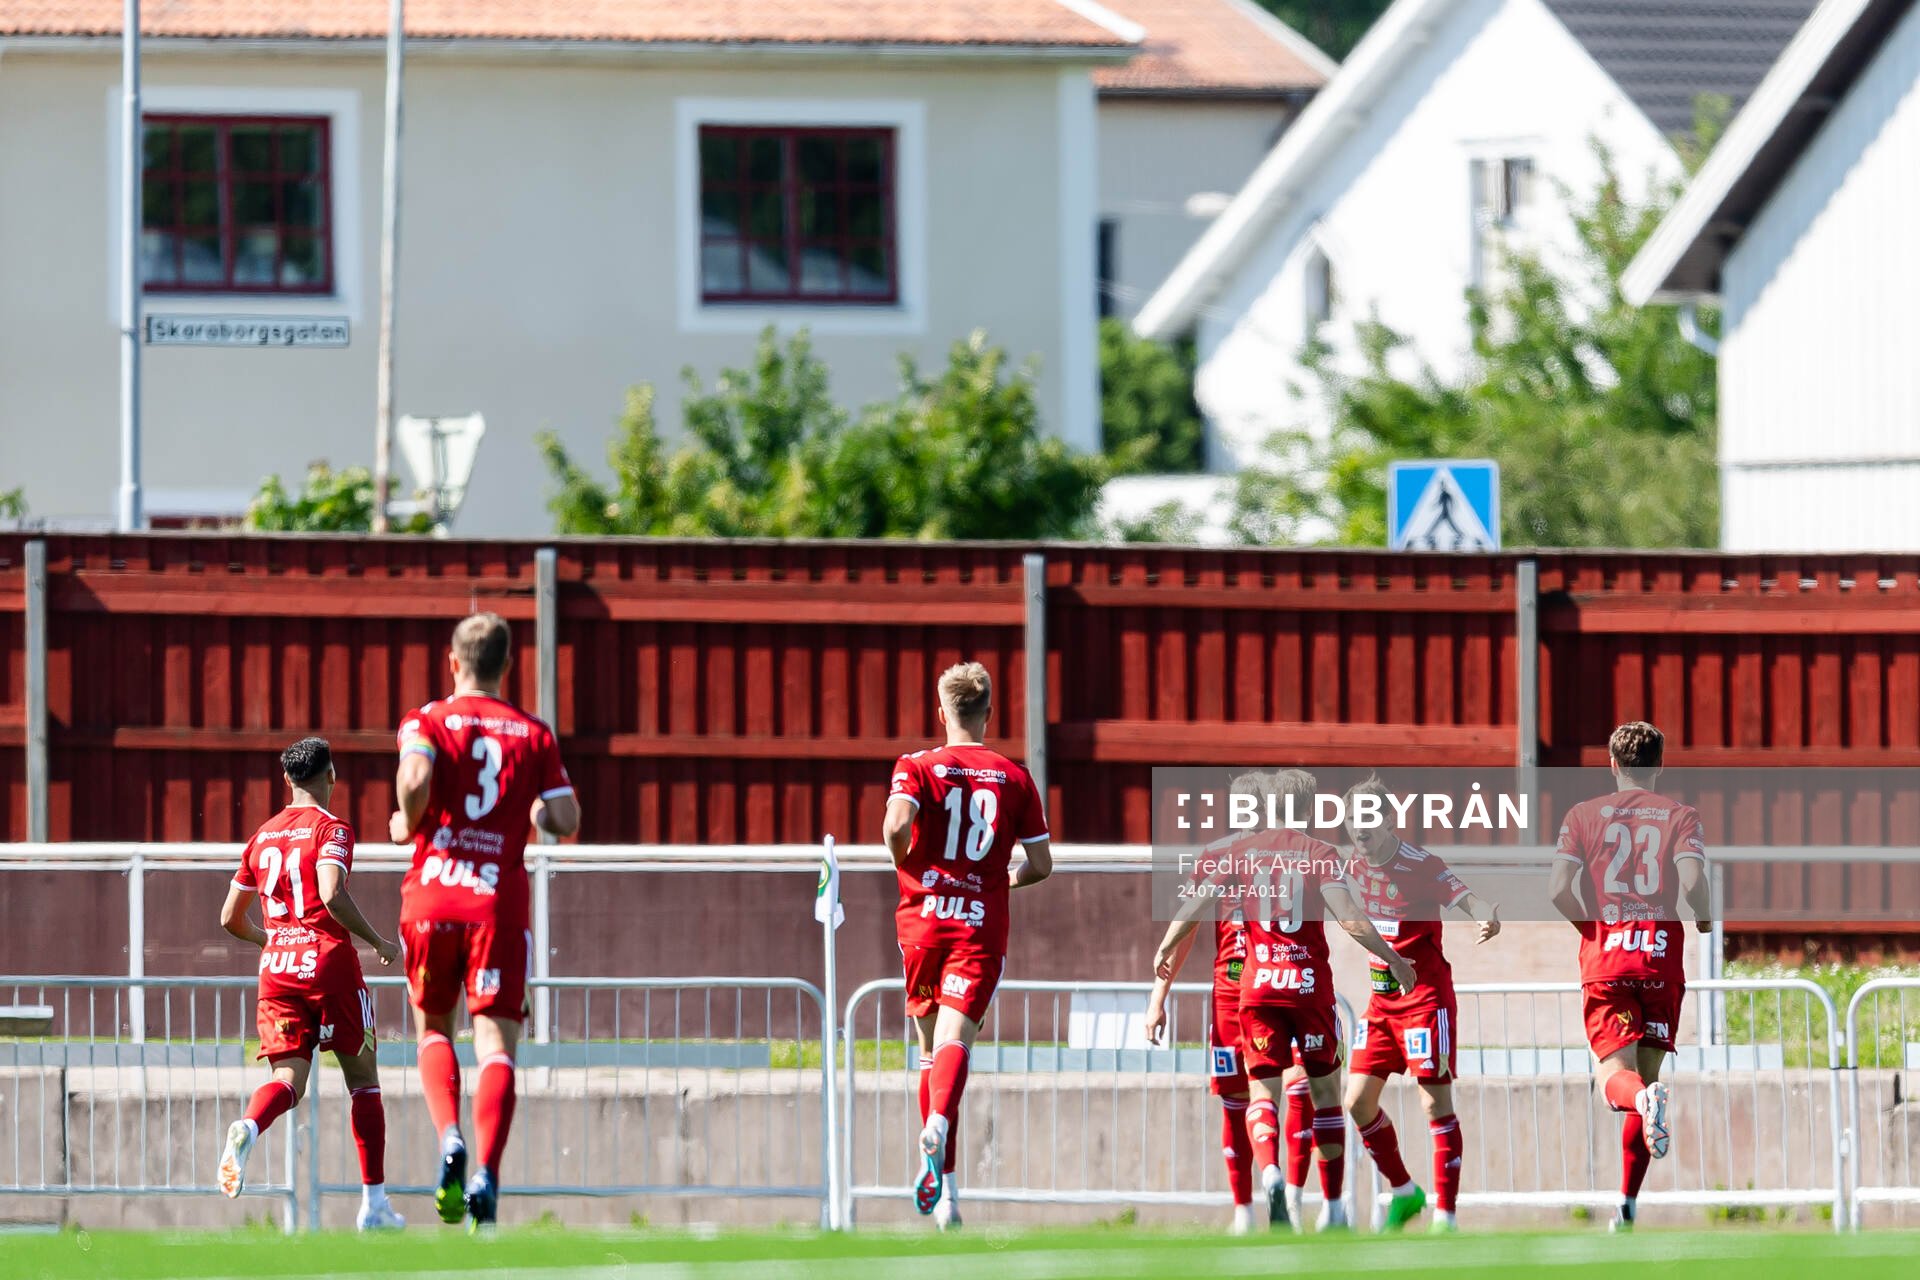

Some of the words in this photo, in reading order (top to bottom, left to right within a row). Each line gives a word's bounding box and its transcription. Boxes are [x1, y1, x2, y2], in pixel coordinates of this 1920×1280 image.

[155, 320, 346, 346] Skaraborgsgatan
[465, 736, 502, 821] 3
[947, 767, 1006, 779] CONTRACTING
[265, 828, 312, 840] CONTRACTING
[943, 787, 998, 861] 18
[420, 856, 500, 889] PULS
[1604, 823, 1661, 896] 23
[259, 846, 304, 919] 21
[920, 894, 985, 920] PULS
[1253, 865, 1304, 934] 19
[1604, 929, 1668, 952] PULS
[259, 950, 318, 975] PULS
[943, 973, 972, 994] SN
[1253, 967, 1315, 989] PULS
